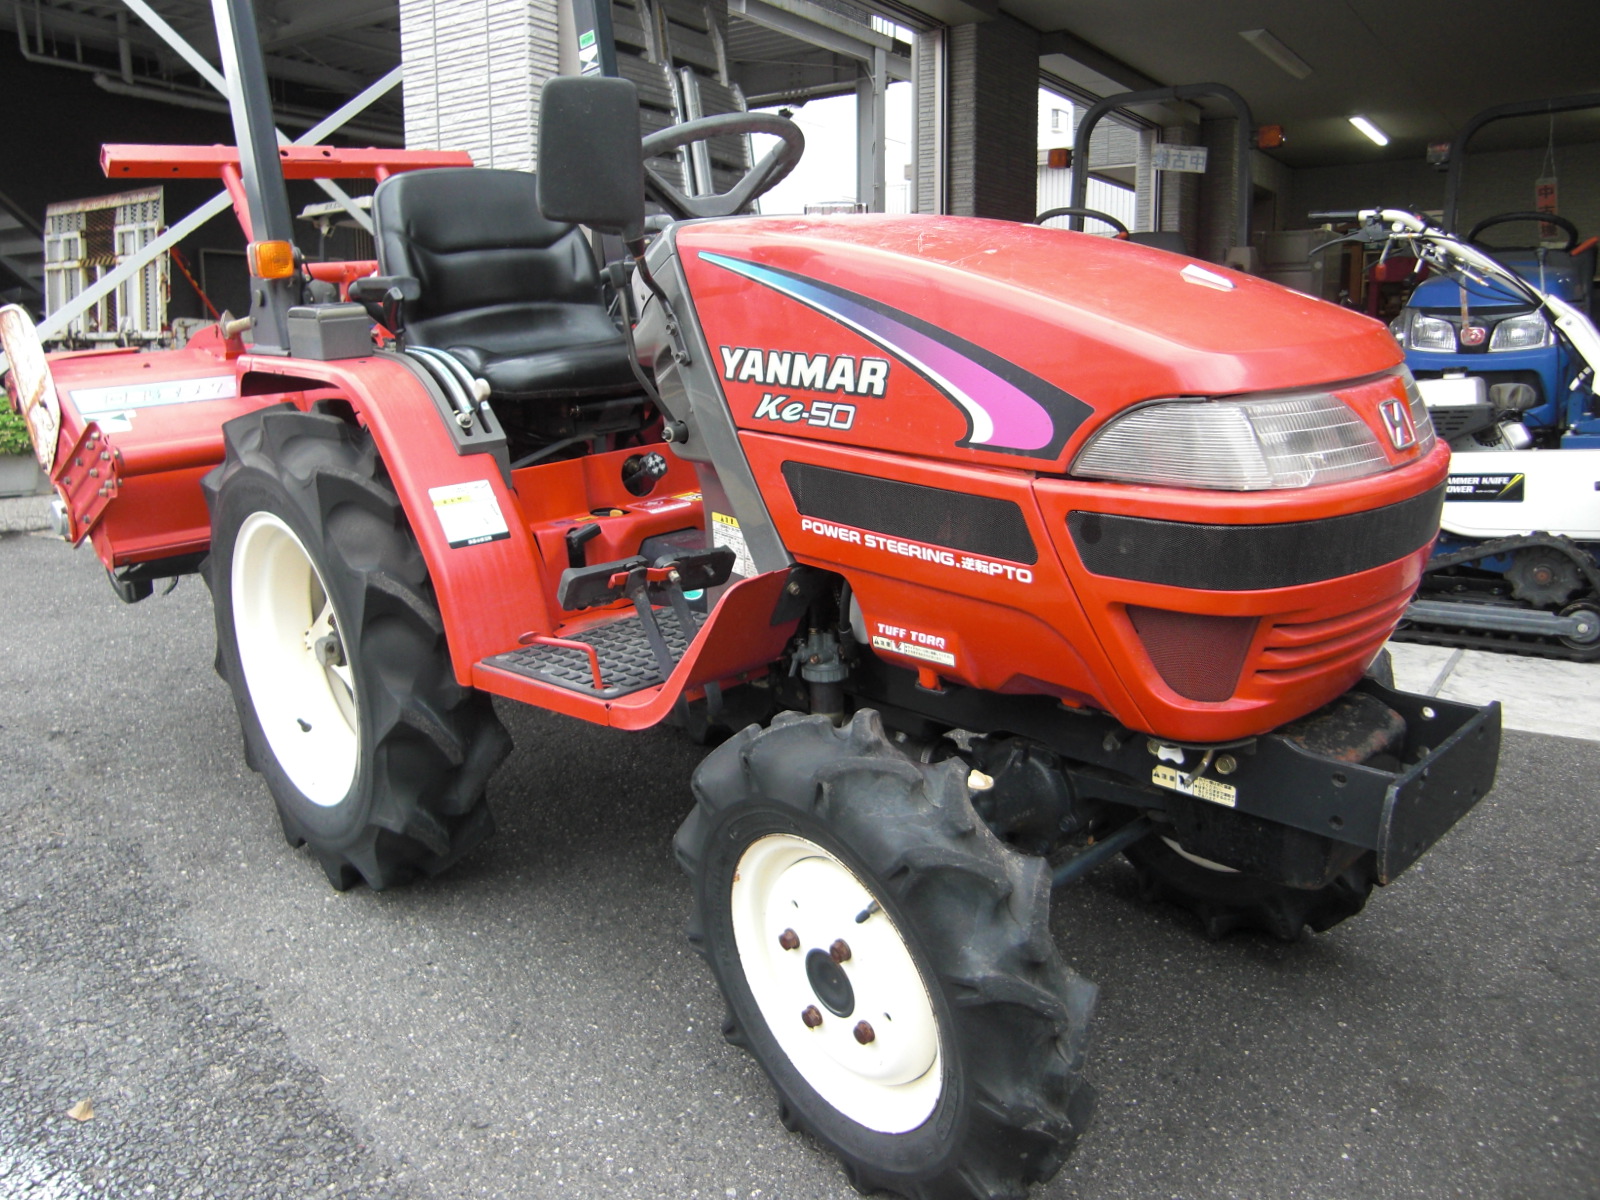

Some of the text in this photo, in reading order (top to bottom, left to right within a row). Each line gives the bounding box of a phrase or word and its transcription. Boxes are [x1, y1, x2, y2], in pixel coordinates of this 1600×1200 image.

[720, 346, 890, 398] YANMAR
[754, 394, 856, 430] Ke-50
[1448, 477, 1509, 485] AMMER KNIFE
[801, 519, 861, 543] POWER
[877, 623, 945, 648] TUFF TORQ
